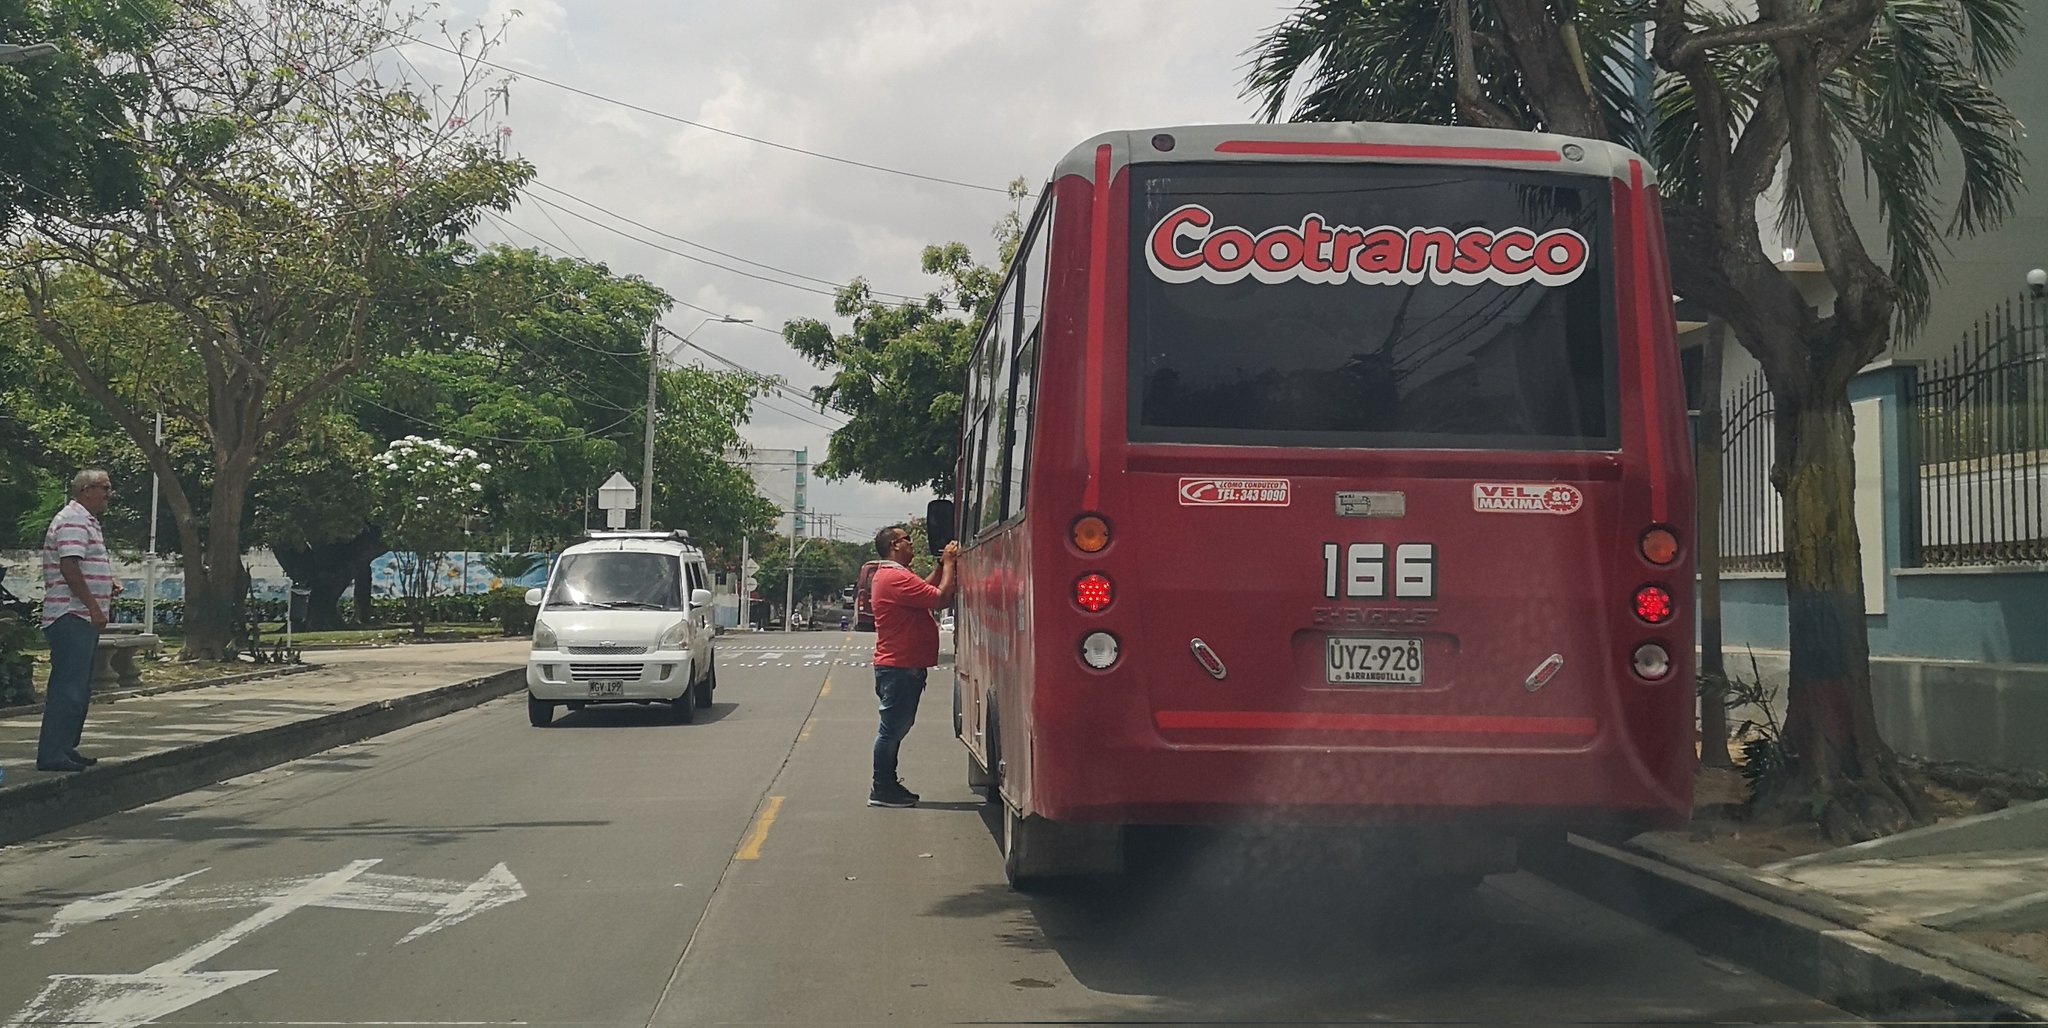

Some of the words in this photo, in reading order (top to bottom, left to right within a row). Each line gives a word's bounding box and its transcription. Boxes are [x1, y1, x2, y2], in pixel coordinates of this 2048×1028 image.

[1148, 205, 1588, 282] Cootransco
[1217, 489, 1240, 500] TEL:
[1240, 490, 1259, 501] 343
[1260, 490, 1286, 501] 9090
[1479, 486, 1540, 497] VEL.
[1552, 491, 1571, 501] 80
[1479, 498, 1544, 509] MAXIMA
[1325, 543, 1435, 598] 166
[1345, 672, 1405, 681] BARRANQUILLA
